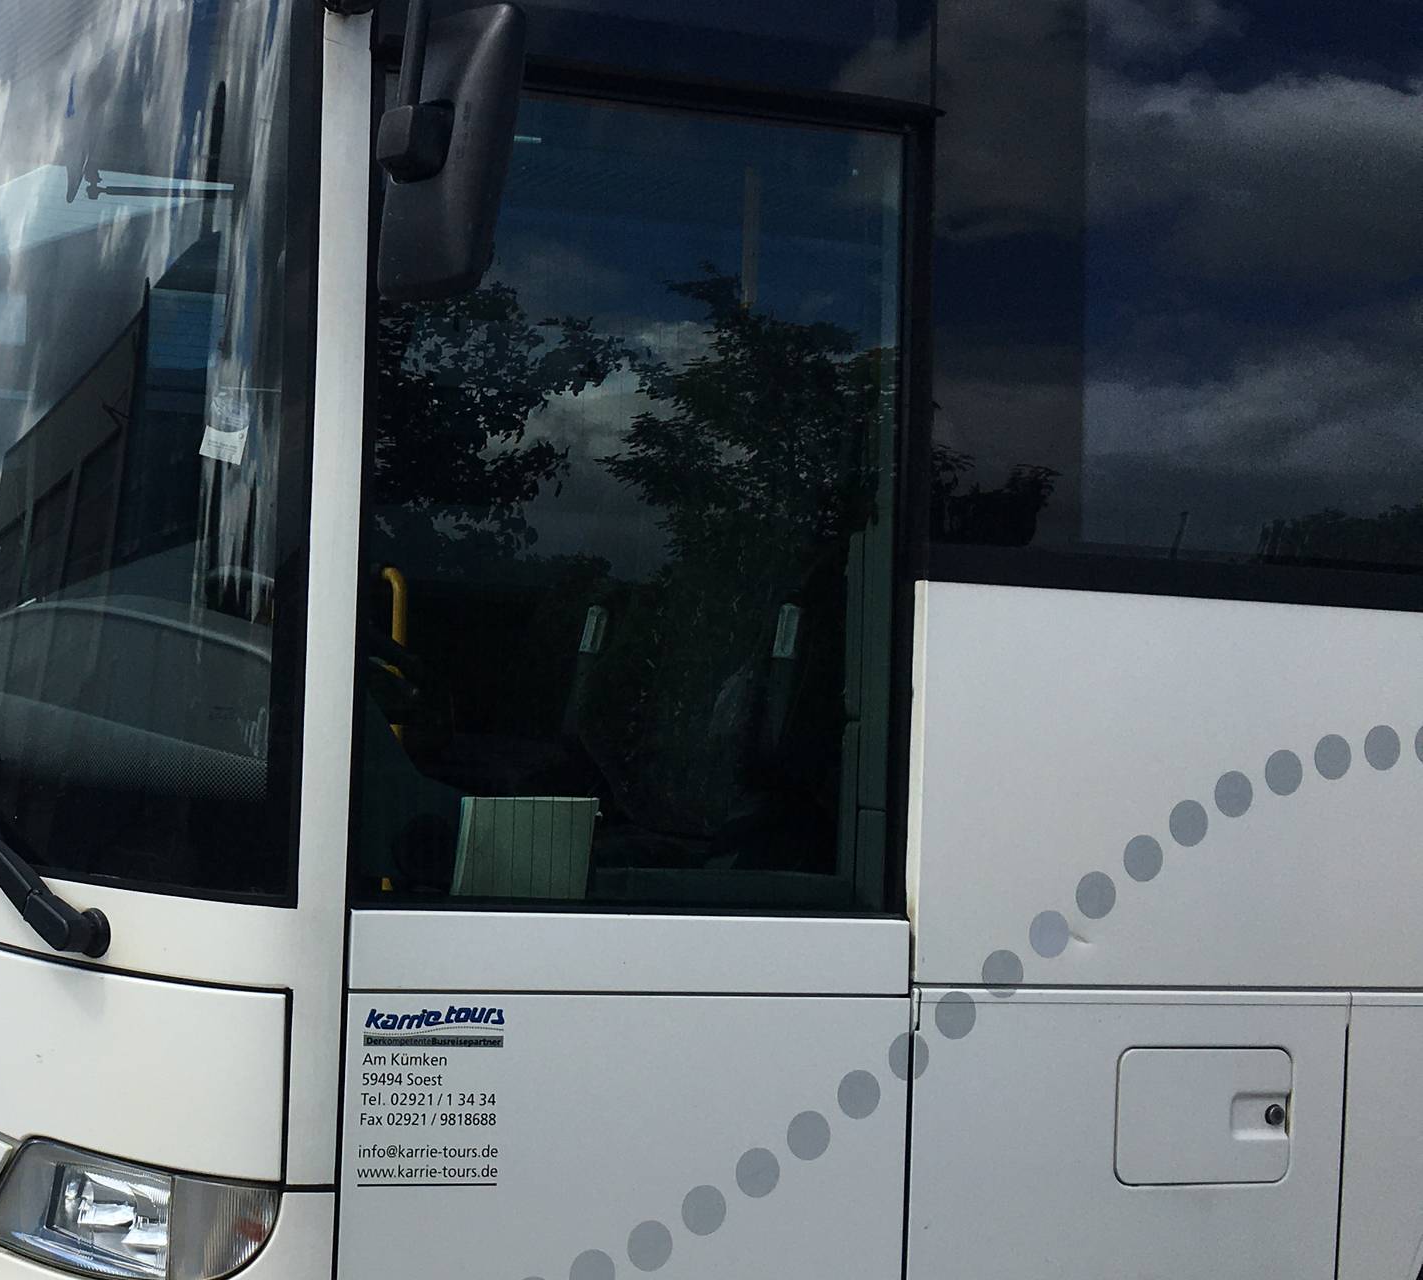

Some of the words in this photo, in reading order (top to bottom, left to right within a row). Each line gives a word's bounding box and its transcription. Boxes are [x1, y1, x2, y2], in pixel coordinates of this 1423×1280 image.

[365, 1008, 444, 1030] karrie
[445, 1005, 505, 1025] tours
[362, 1053, 386, 1066] Am
[391, 1053, 447, 1066] Kümken
[362, 1073, 402, 1086] 59494
[407, 1073, 443, 1086] Soest
[361, 1093, 386, 1106] Tel.
[390, 1093, 433, 1106] 02921
[360, 1113, 383, 1126] Fax
[387, 1113, 426, 1126] 02921
[440, 1113, 496, 1126] 9818688
[358, 1144, 498, 1158] info@karrie-tours.de
[357, 1164, 498, 1178] www.karrie-tours.de
